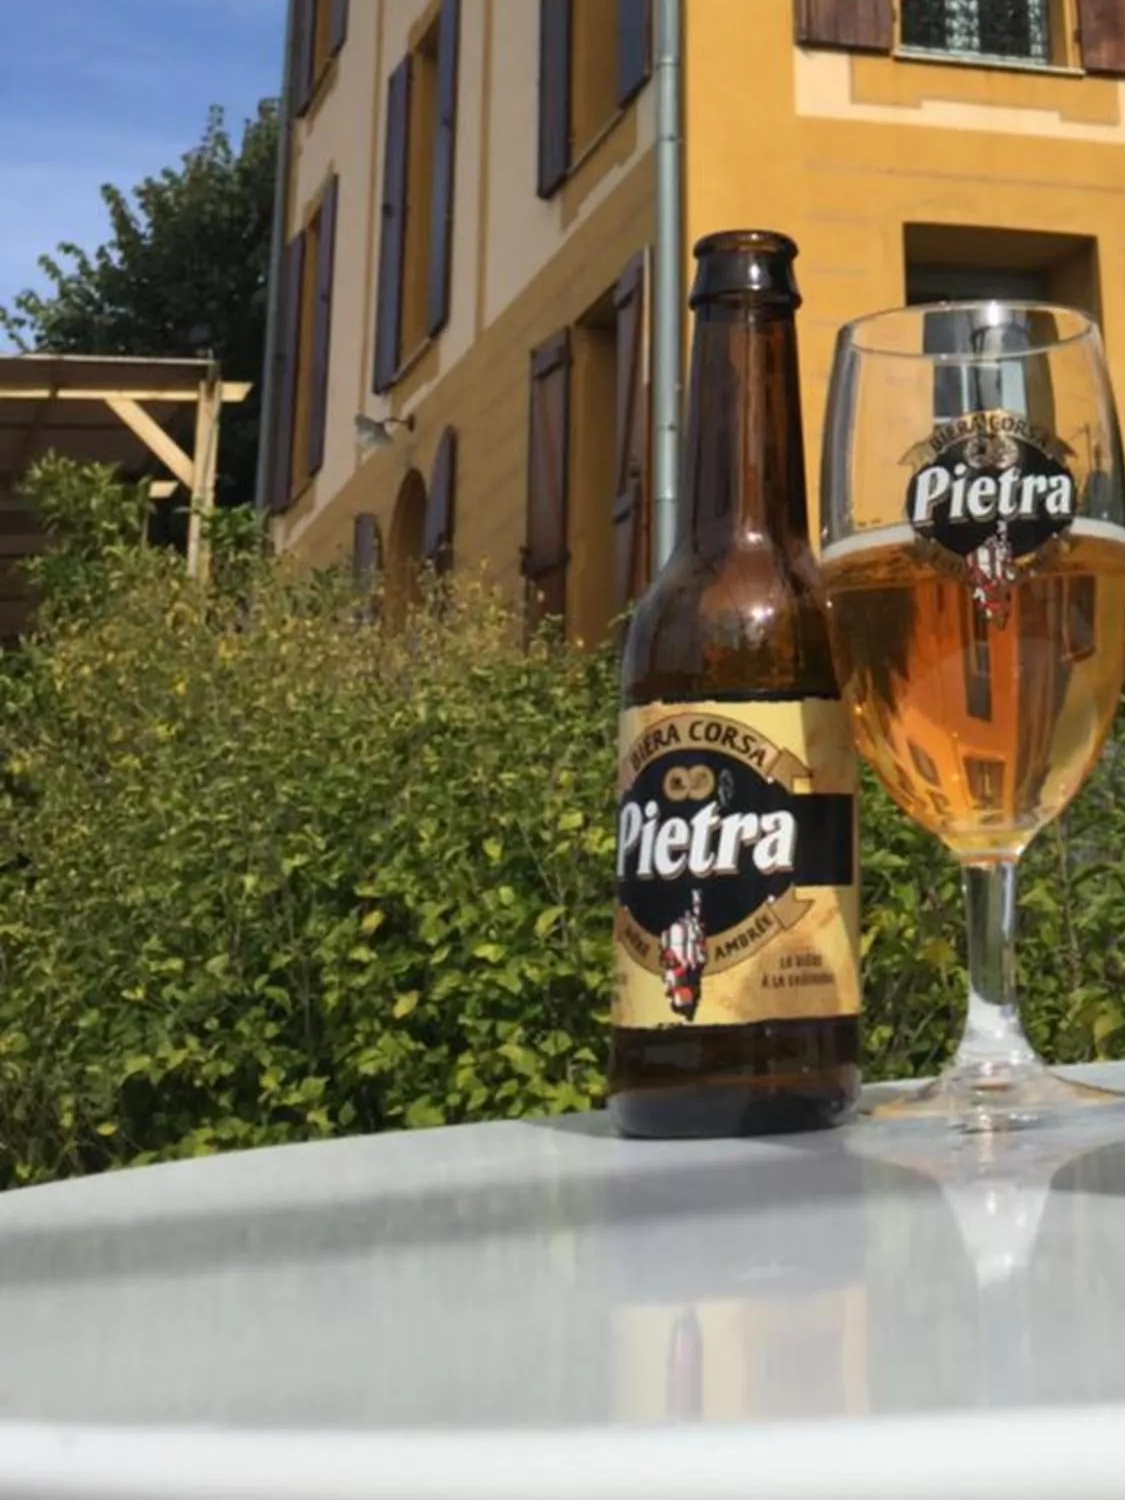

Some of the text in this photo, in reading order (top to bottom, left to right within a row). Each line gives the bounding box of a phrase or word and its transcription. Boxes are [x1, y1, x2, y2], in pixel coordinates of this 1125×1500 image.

[912, 463, 1076, 528] Pietra
[629, 719, 768, 772] BIERA CORSA
[616, 799, 799, 880] Pietra
